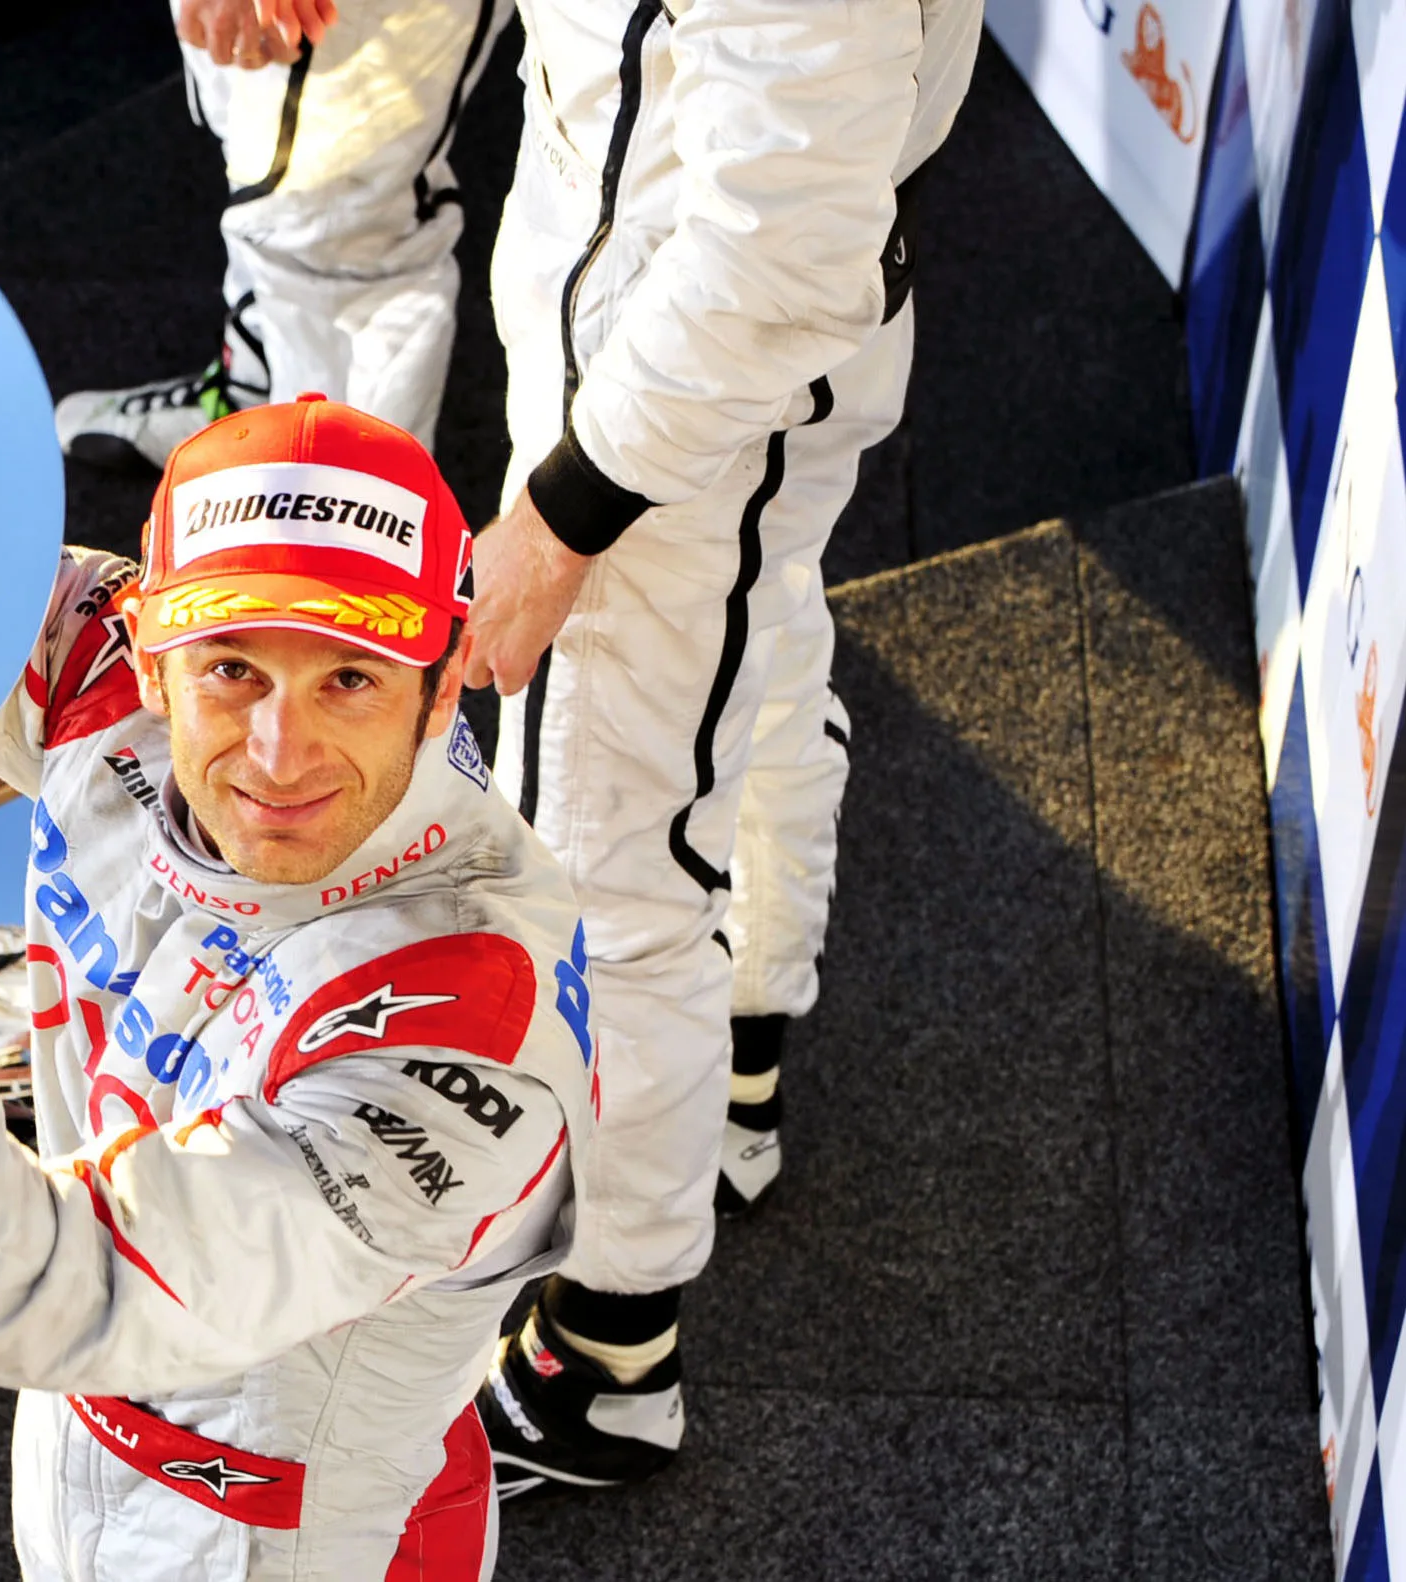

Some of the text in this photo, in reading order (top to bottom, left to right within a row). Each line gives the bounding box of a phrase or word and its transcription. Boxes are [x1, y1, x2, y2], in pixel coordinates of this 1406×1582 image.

[184, 492, 416, 548] BRIDGESTONE
[150, 853, 261, 916] DENSO
[320, 823, 446, 907] DENSO
[401, 1060, 524, 1139] KDDI
[74, 1394, 140, 1449] ULLI
